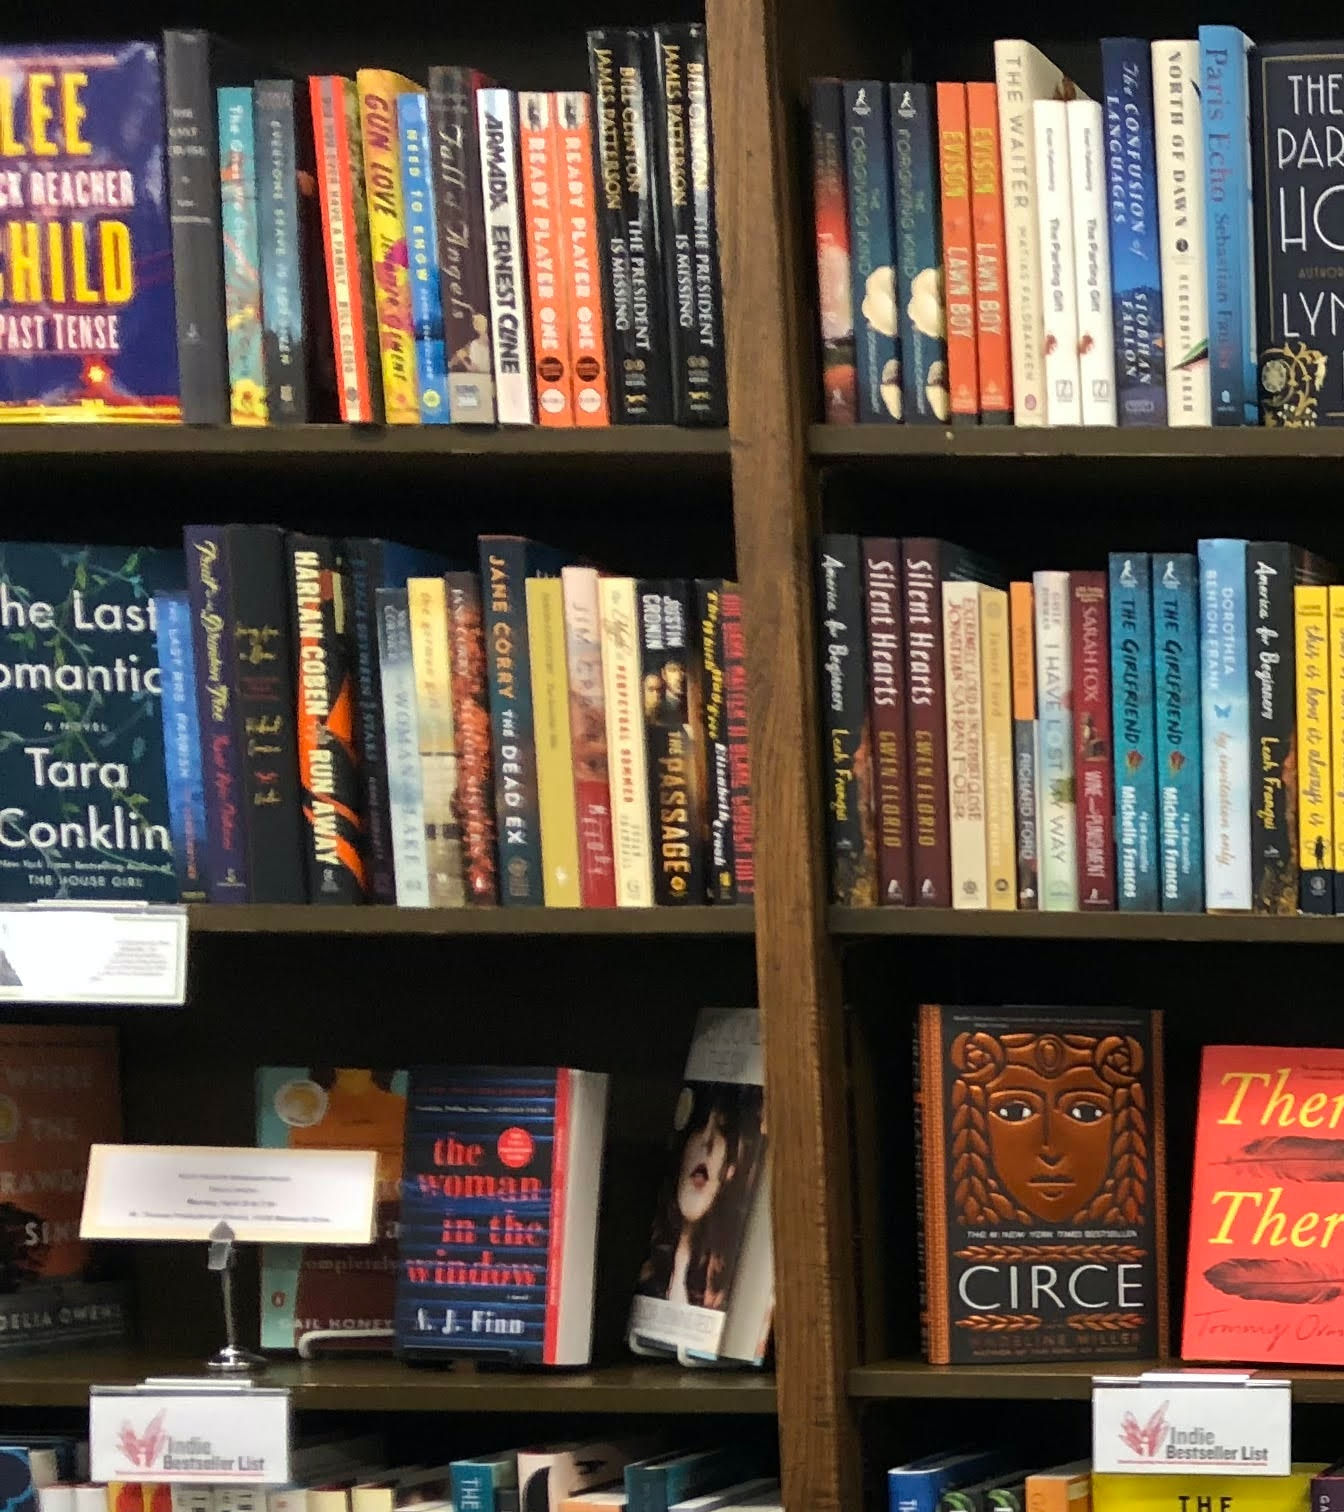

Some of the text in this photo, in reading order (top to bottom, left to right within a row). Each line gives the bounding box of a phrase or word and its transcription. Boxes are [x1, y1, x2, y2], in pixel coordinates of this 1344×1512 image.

[1288, 74, 1344, 115] THE
[31, 170, 134, 206] REACHER
[526, 134, 558, 350] READY PLAYER ONE
[24, 748, 128, 788] Tara
[418, 1172, 541, 1201] woman
[958, 1263, 1145, 1312] CIRCE
